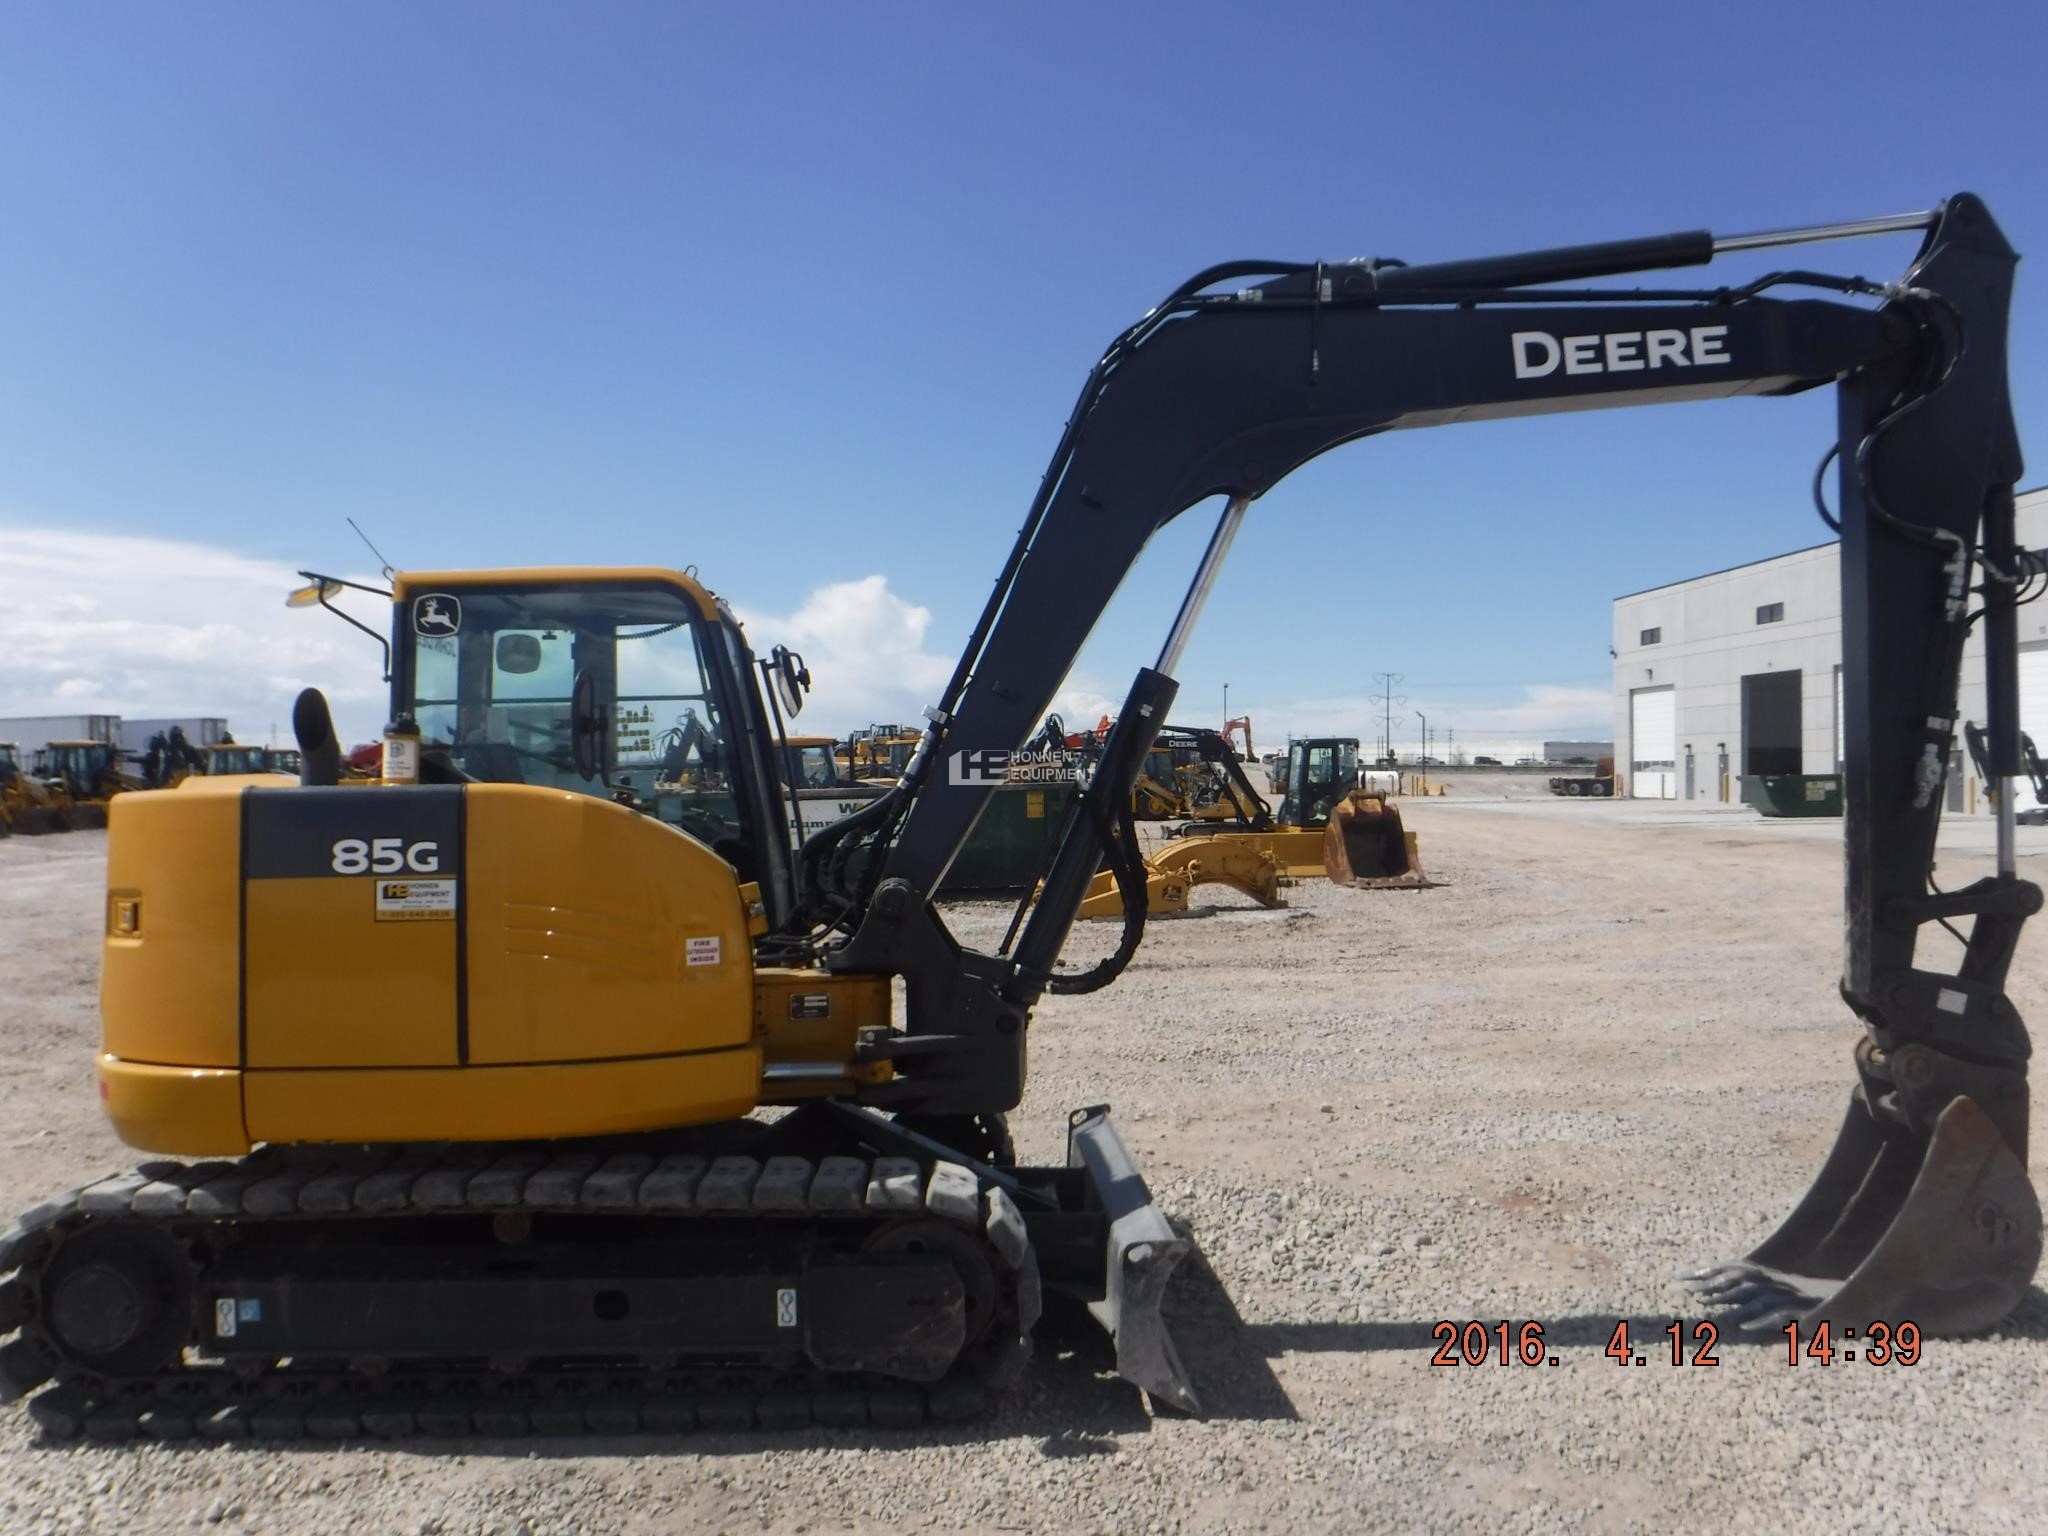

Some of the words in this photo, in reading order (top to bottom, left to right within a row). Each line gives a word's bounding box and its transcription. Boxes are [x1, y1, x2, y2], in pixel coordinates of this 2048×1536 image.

[1511, 325, 1731, 380] DEERE
[1168, 740, 1198, 748] DEERE
[332, 838, 439, 874] 85G
